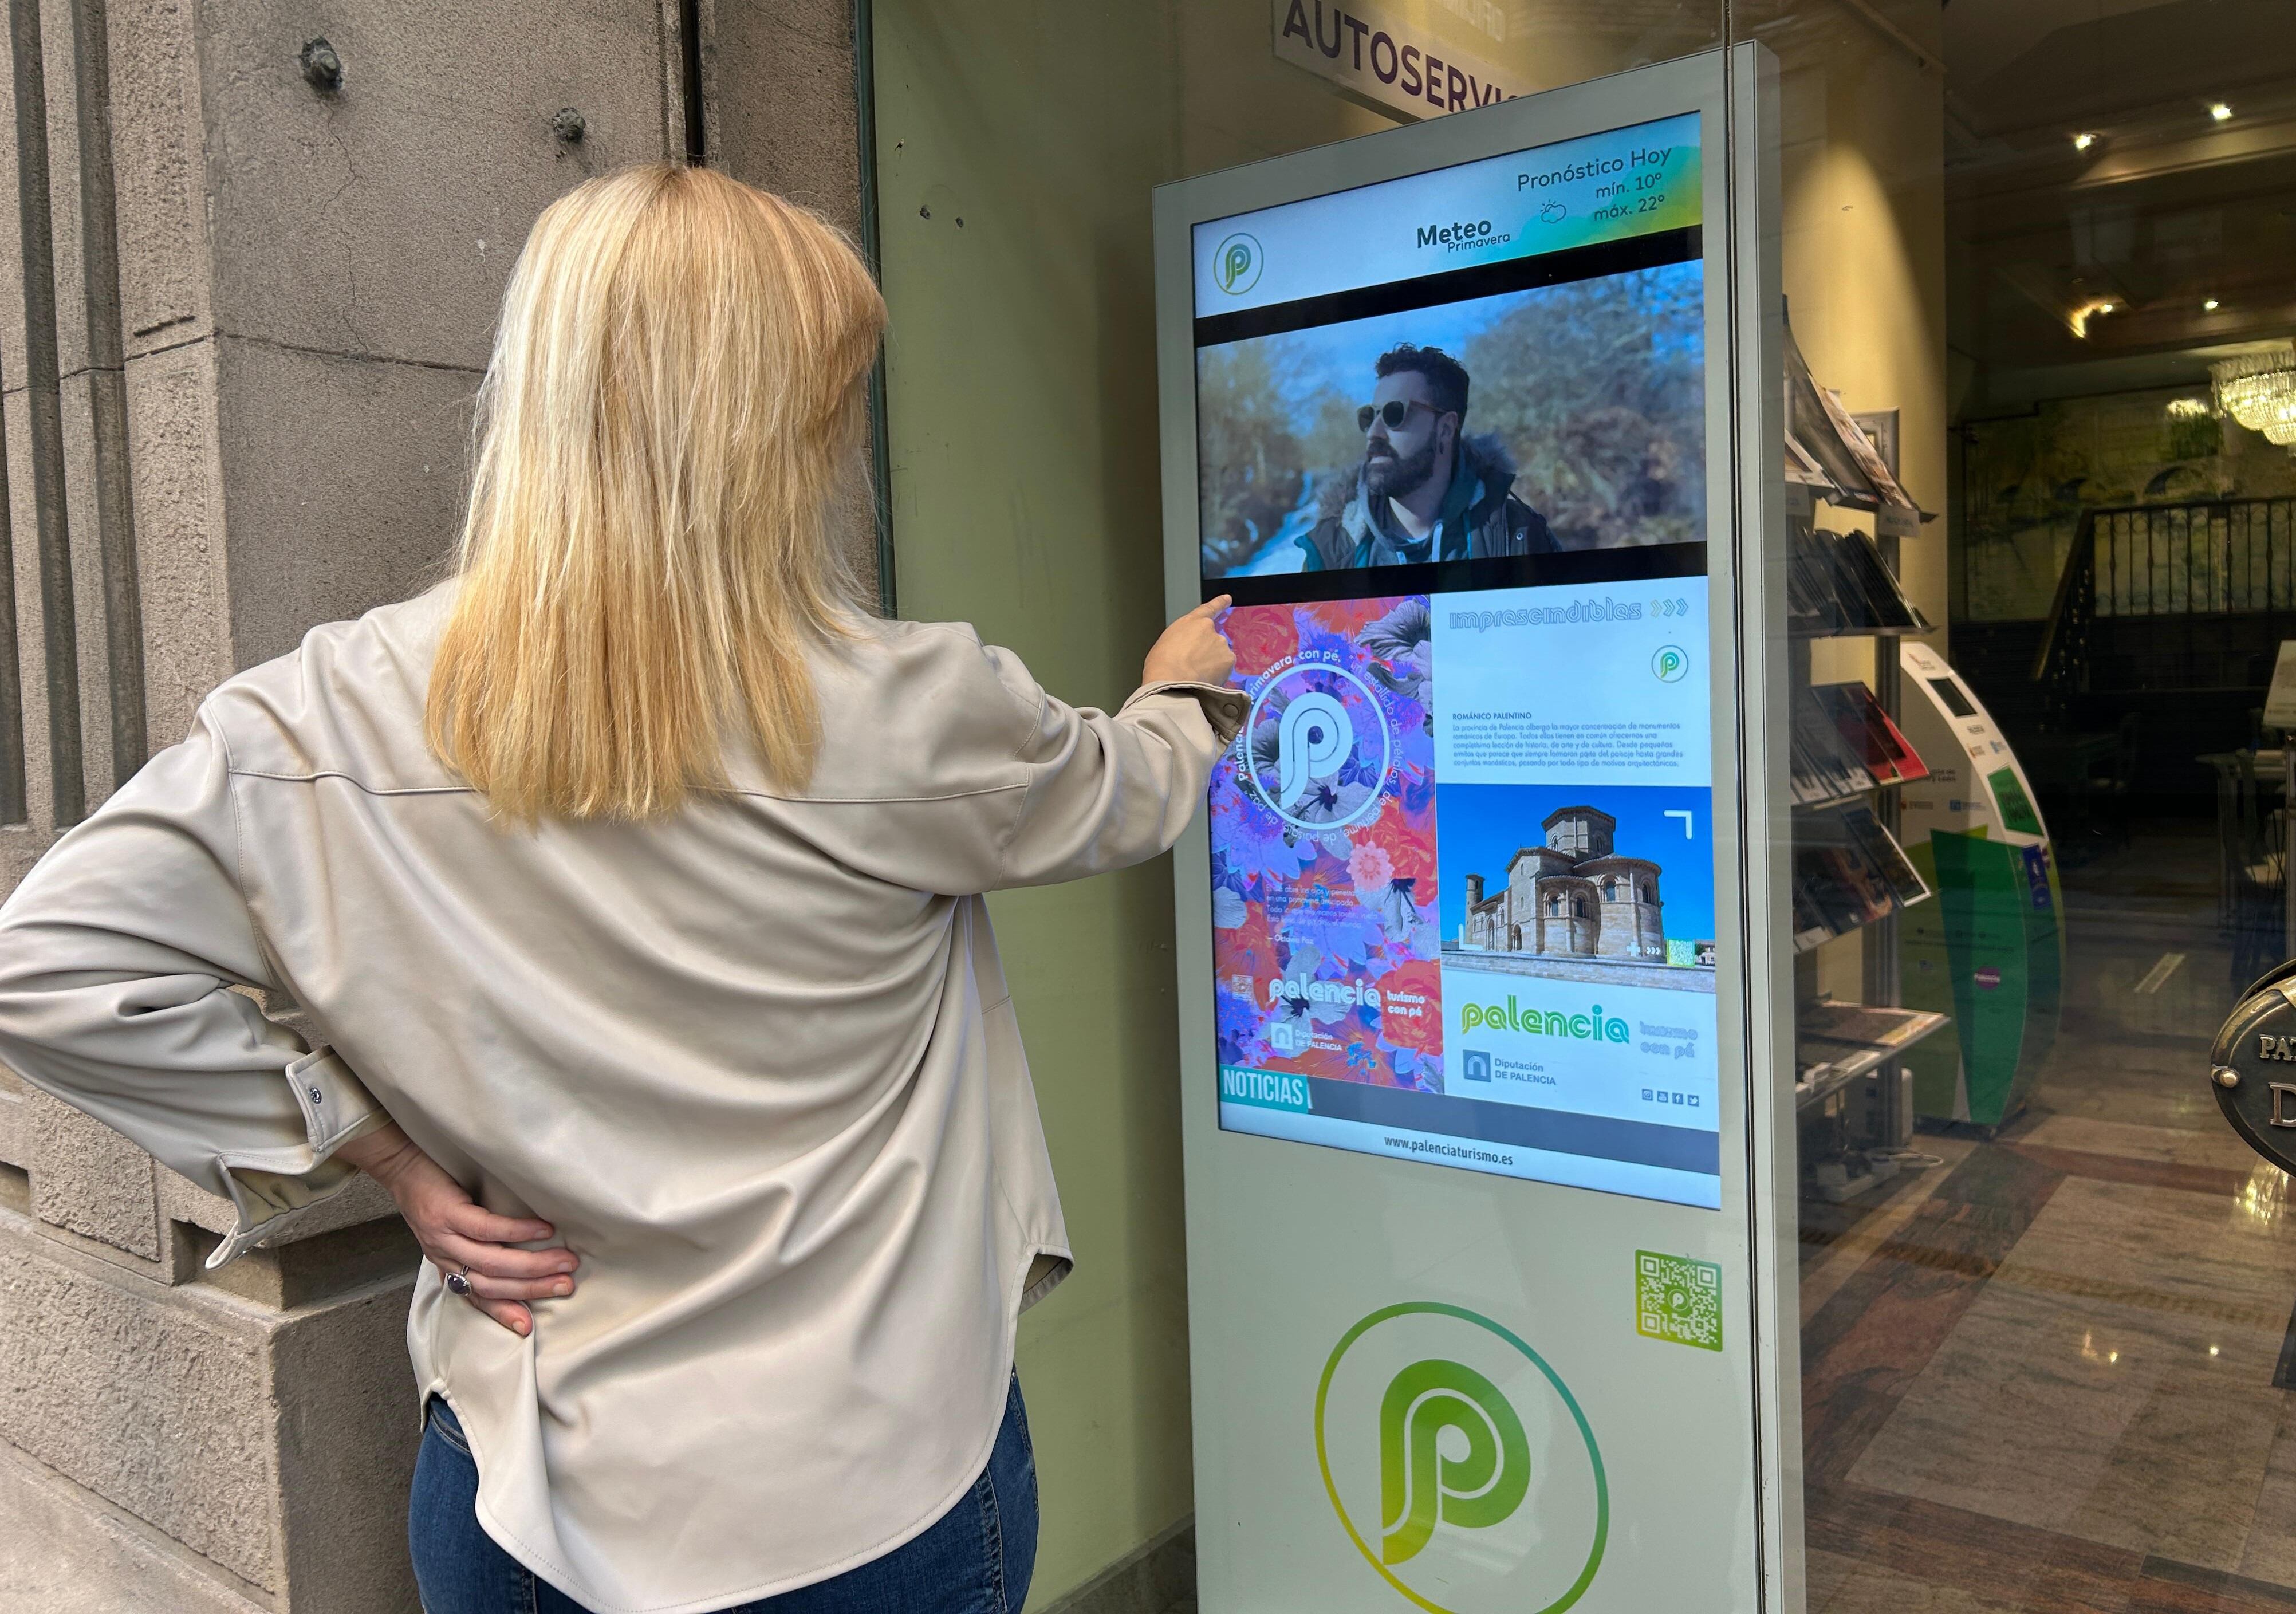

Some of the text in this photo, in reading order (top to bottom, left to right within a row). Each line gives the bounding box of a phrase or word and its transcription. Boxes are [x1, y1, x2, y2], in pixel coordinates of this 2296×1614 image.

[1518, 147, 1672, 191] Pronóstico Hoy
[1596, 182, 1629, 199] mín.
[1594, 204, 1632, 221] máx.
[1417, 219, 1492, 248] Meteo
[1448, 233, 1510, 253] Primavera
[1299, 649, 1319, 660] con
[1364, 672, 1394, 715] estallido
[1452, 711, 1491, 720] ROMÁNICO
[1391, 718, 1402, 734] de
[1461, 724, 1487, 732] provincia
[1499, 723, 1524, 731] Palencia
[1656, 749, 1683, 759] grandes
[1519, 759, 1546, 768] pasando
[1547, 759, 1558, 768] por
[1577, 759, 1589, 768] tipo
[1591, 758, 1600, 766] de
[1379, 791, 1392, 806] de
[1324, 833, 1336, 845] de
[1269, 972, 1381, 1007] palencia
[1387, 990, 1425, 1005] turismo
[1388, 1006, 1406, 1015] con
[1462, 994, 1630, 1044] palencia
[1295, 1029, 1333, 1041] Diputación
[1295, 1039, 1342, 1052] DE PALENCIA
[1494, 1057, 1544, 1072] Diputación
[1495, 1070, 1557, 1086] DE PALENCIA
[1223, 1069, 1304, 1106] NOTICIAS
[1384, 1136, 1514, 1166] www.palenciaturismo.es
